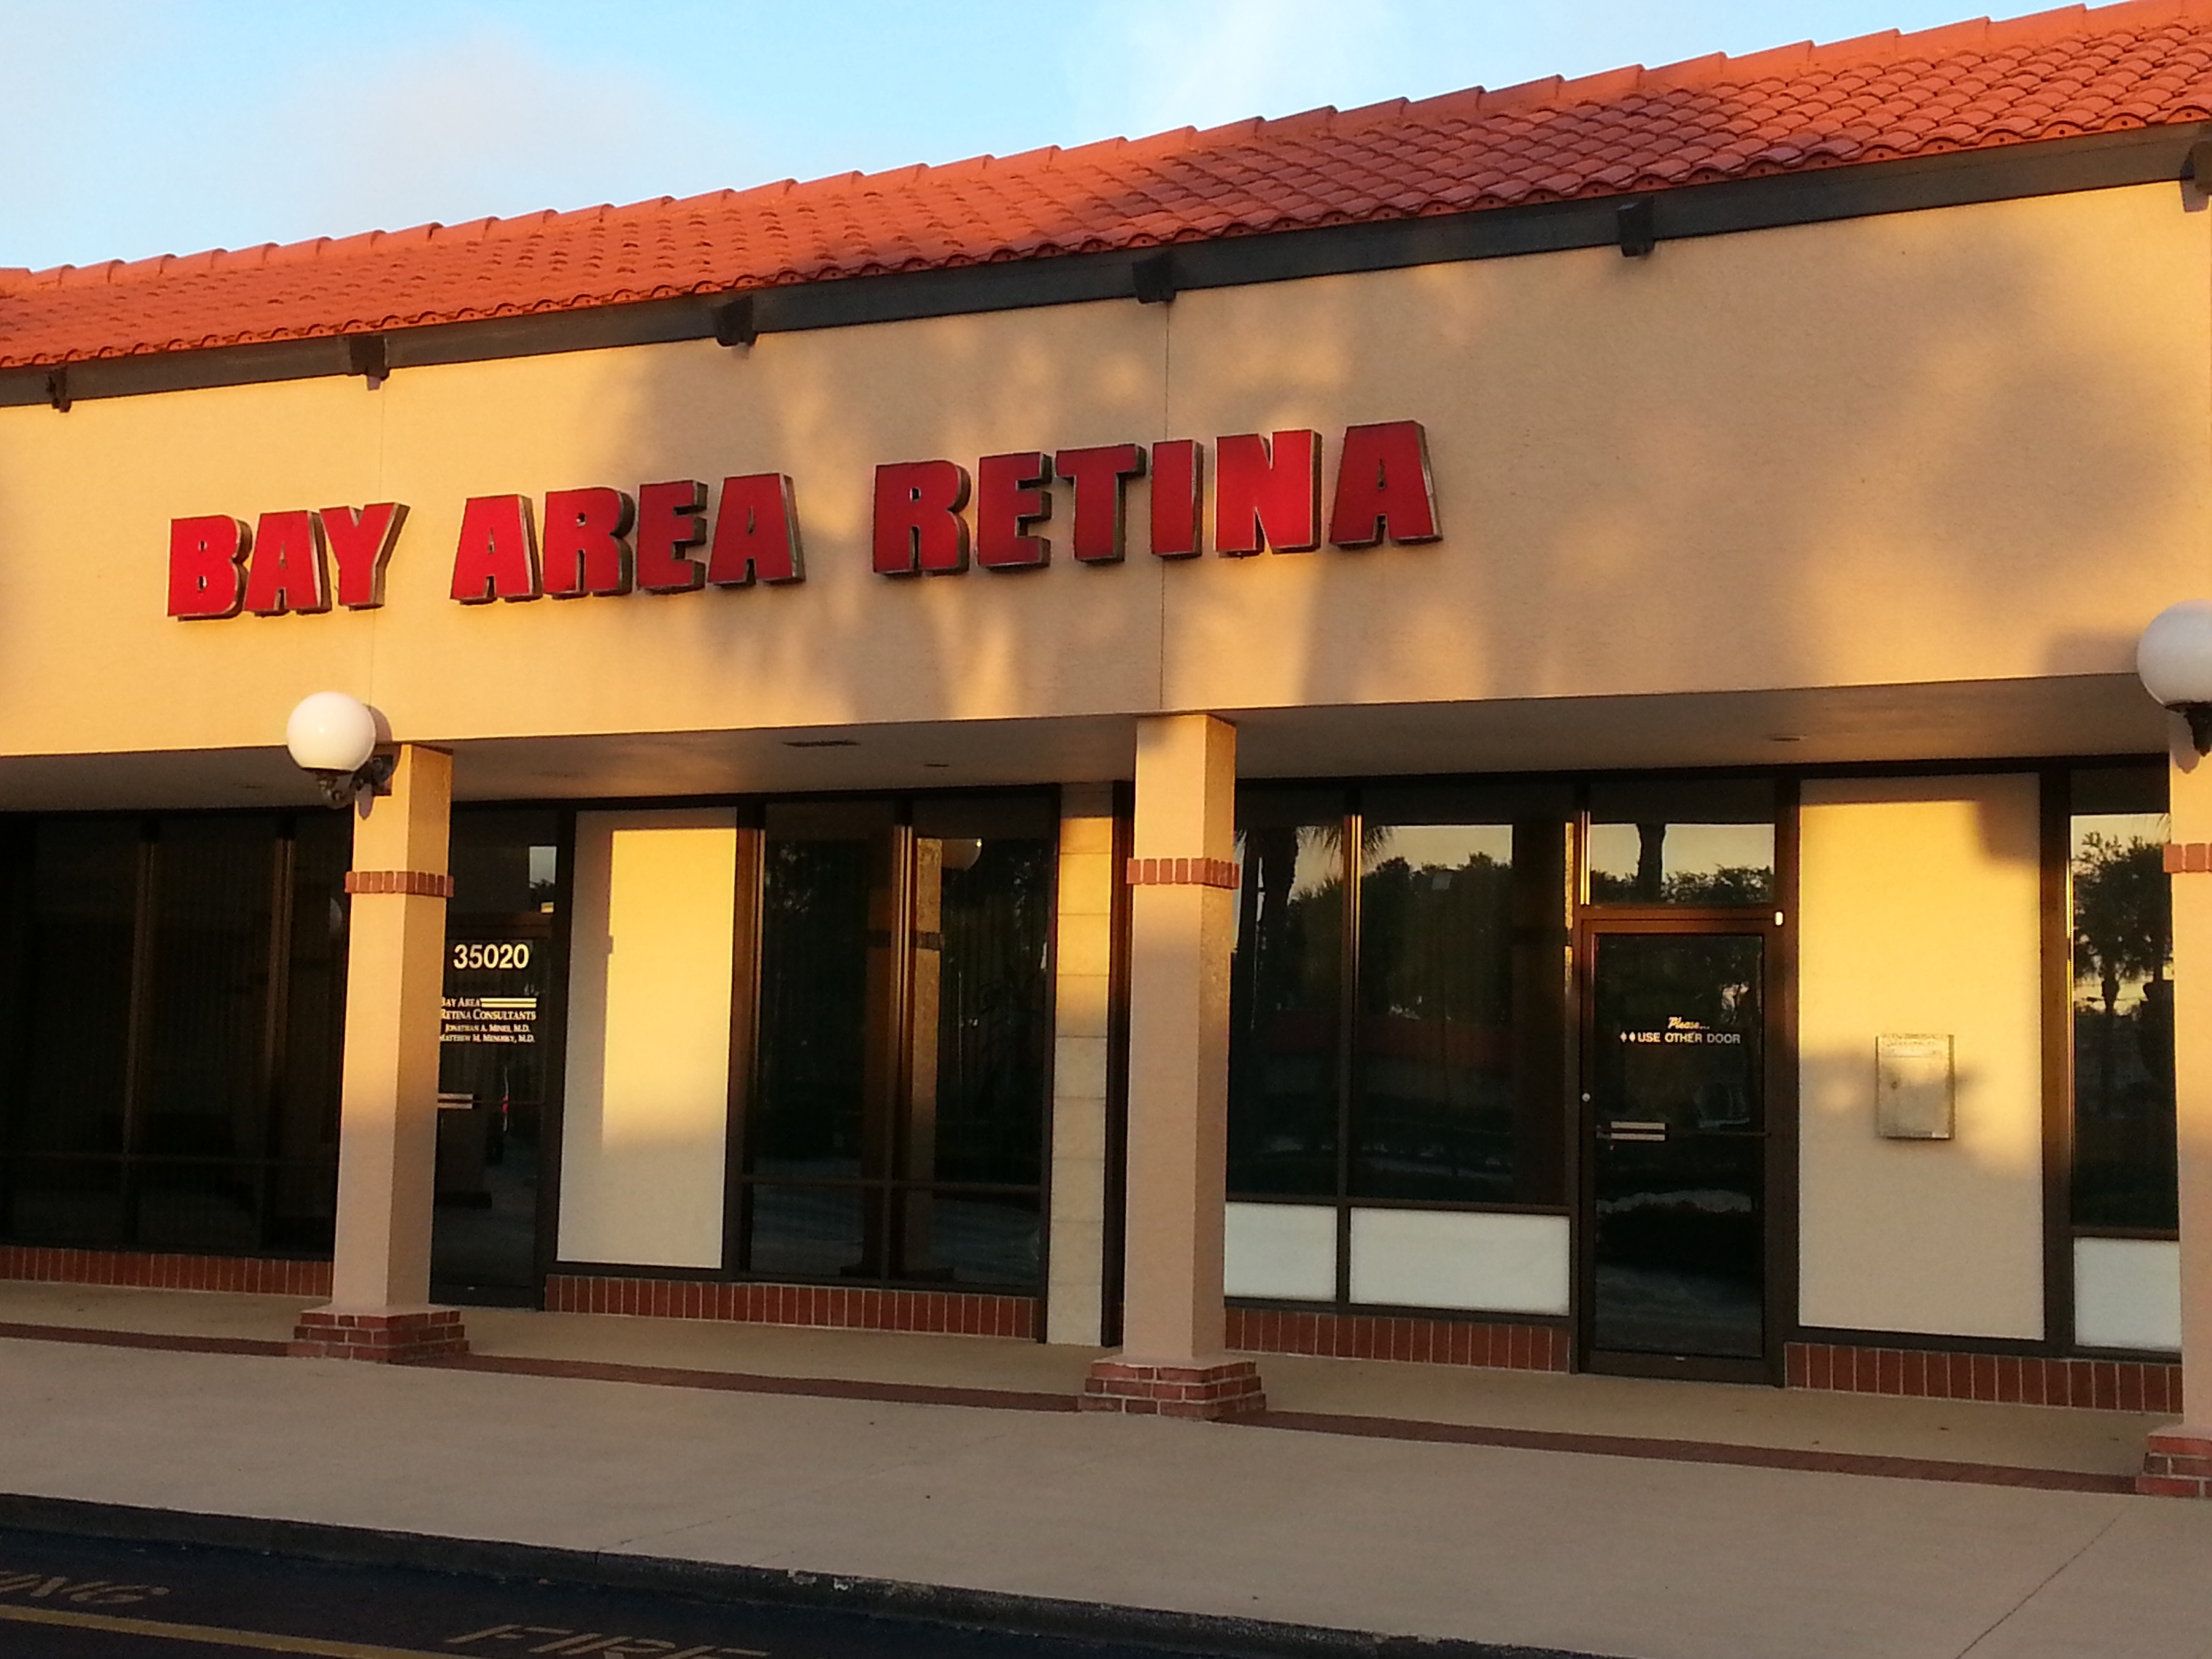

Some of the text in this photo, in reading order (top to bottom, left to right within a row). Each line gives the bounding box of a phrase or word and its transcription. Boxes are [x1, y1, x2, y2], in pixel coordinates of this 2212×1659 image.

[167, 419, 1443, 621] BAY AREA RETINA
[453, 943, 530, 969] 35020
[457, 996, 480, 1007] AREA
[472, 1008, 537, 1021] CONSULTANTS
[1637, 1031, 1741, 1044] USE OTHER DOOR
